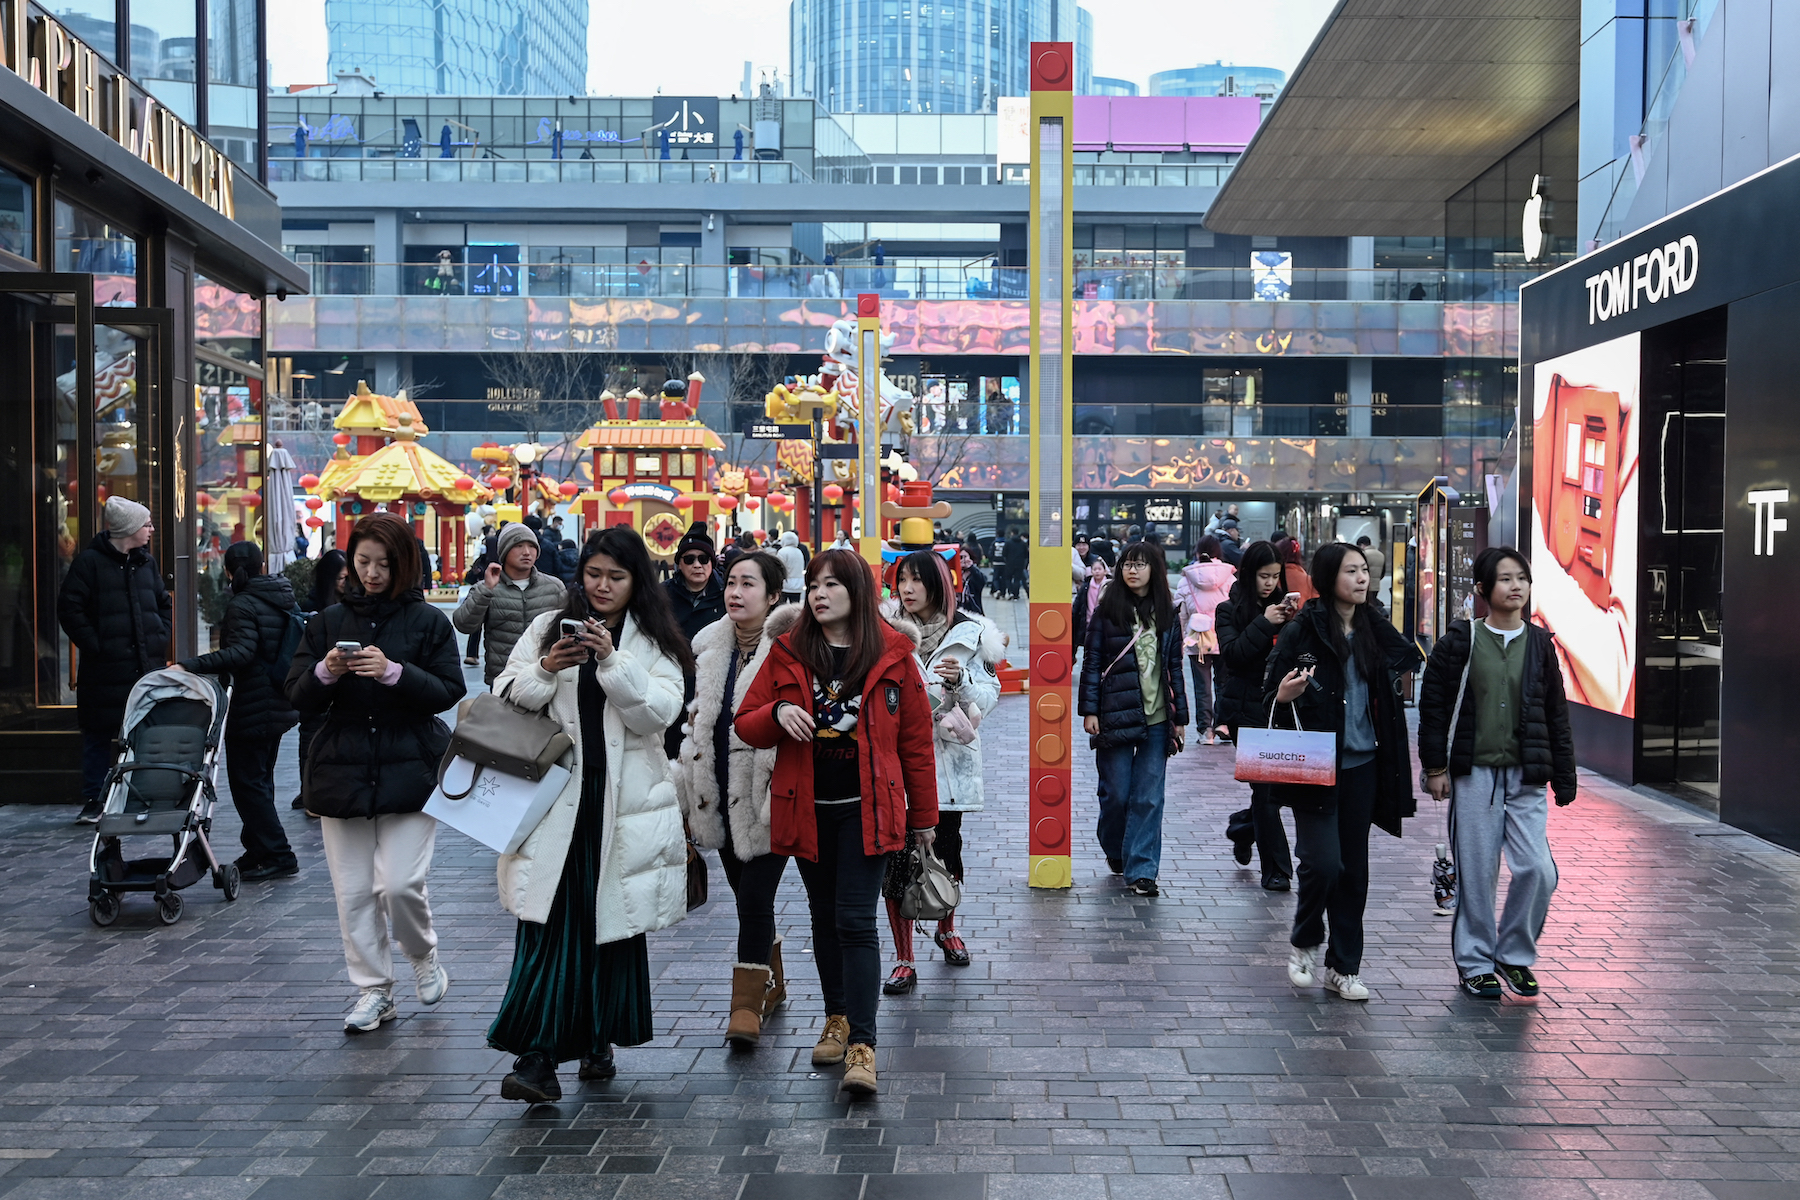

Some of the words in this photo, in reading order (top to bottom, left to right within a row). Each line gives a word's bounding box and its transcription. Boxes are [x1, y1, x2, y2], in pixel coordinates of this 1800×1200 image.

[0, 0, 99, 130] LPH
[115, 73, 235, 221] LAUREN
[664, 100, 705, 131] 小
[1585, 261, 1631, 325] TOM
[1632, 234, 1699, 310] FORD
[1747, 489, 1789, 556] TF
[1258, 751, 1298, 761] swatch
